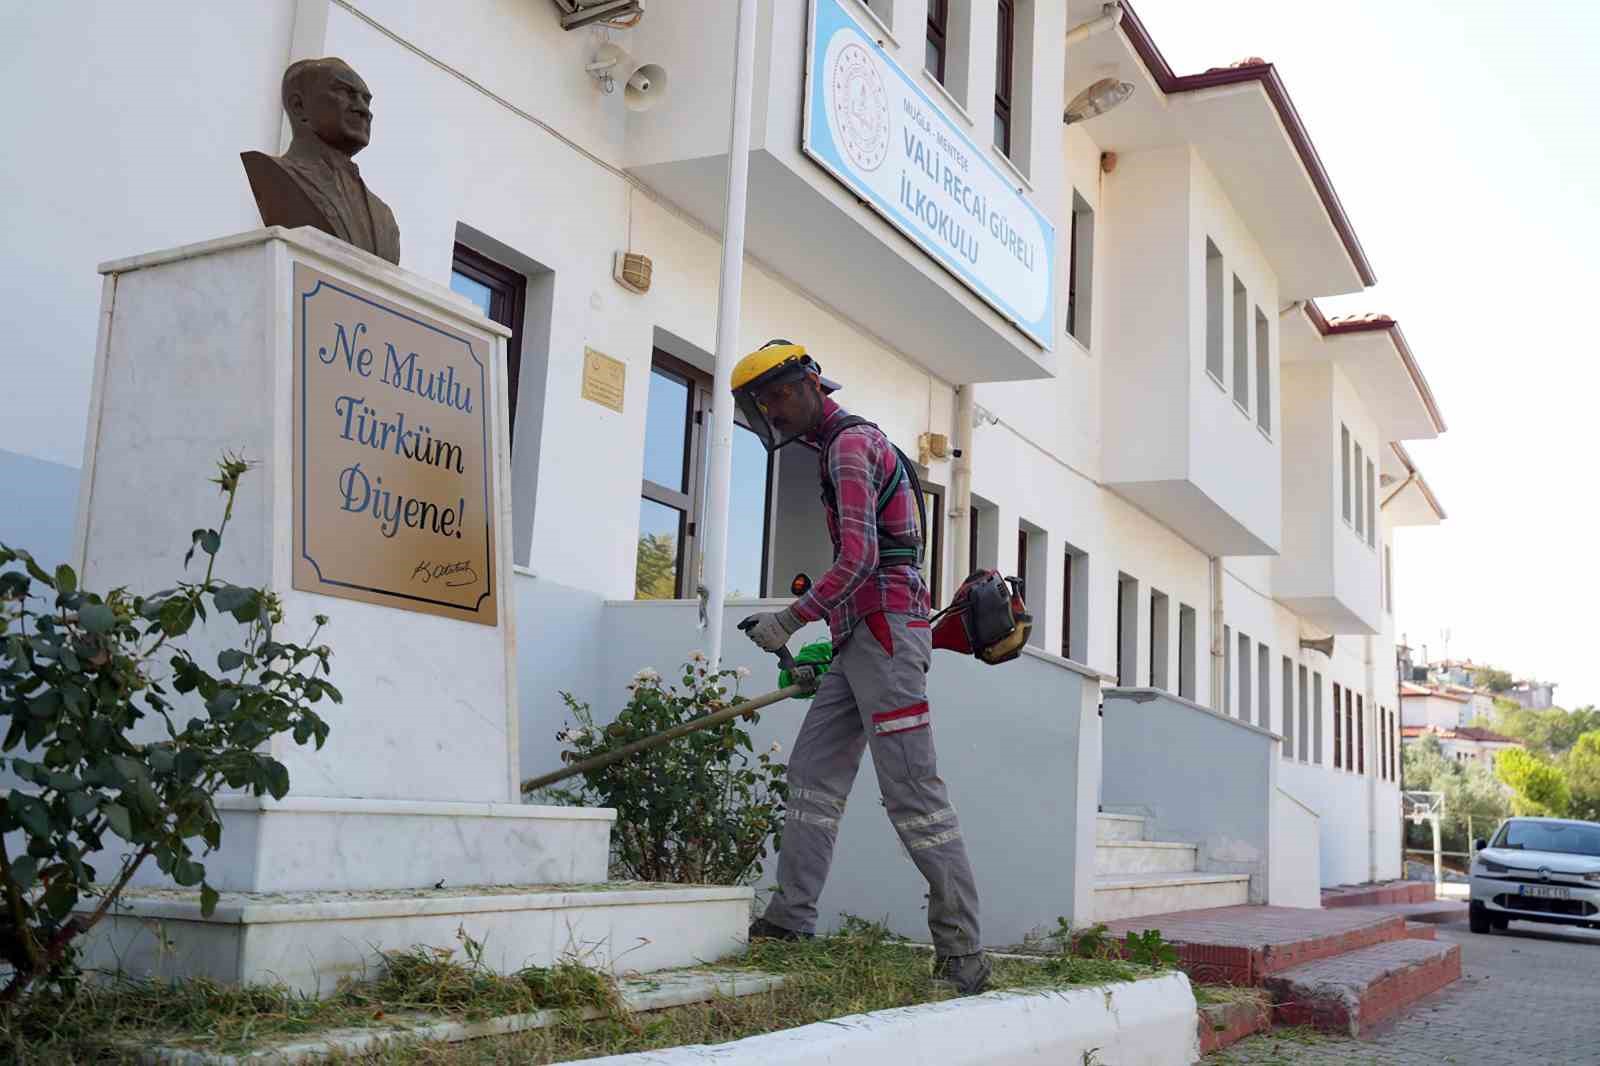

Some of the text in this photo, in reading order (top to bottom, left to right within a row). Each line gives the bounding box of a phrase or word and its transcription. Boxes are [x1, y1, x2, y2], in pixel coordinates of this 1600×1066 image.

[900, 169, 979, 265] İLKOKULU
[903, 125, 1034, 272] VALİ RECAİ GÜRELİ
[318, 322, 473, 413] Ne Mutlu
[334, 395, 465, 474] Türküm
[338, 463, 465, 539] Diyene!
